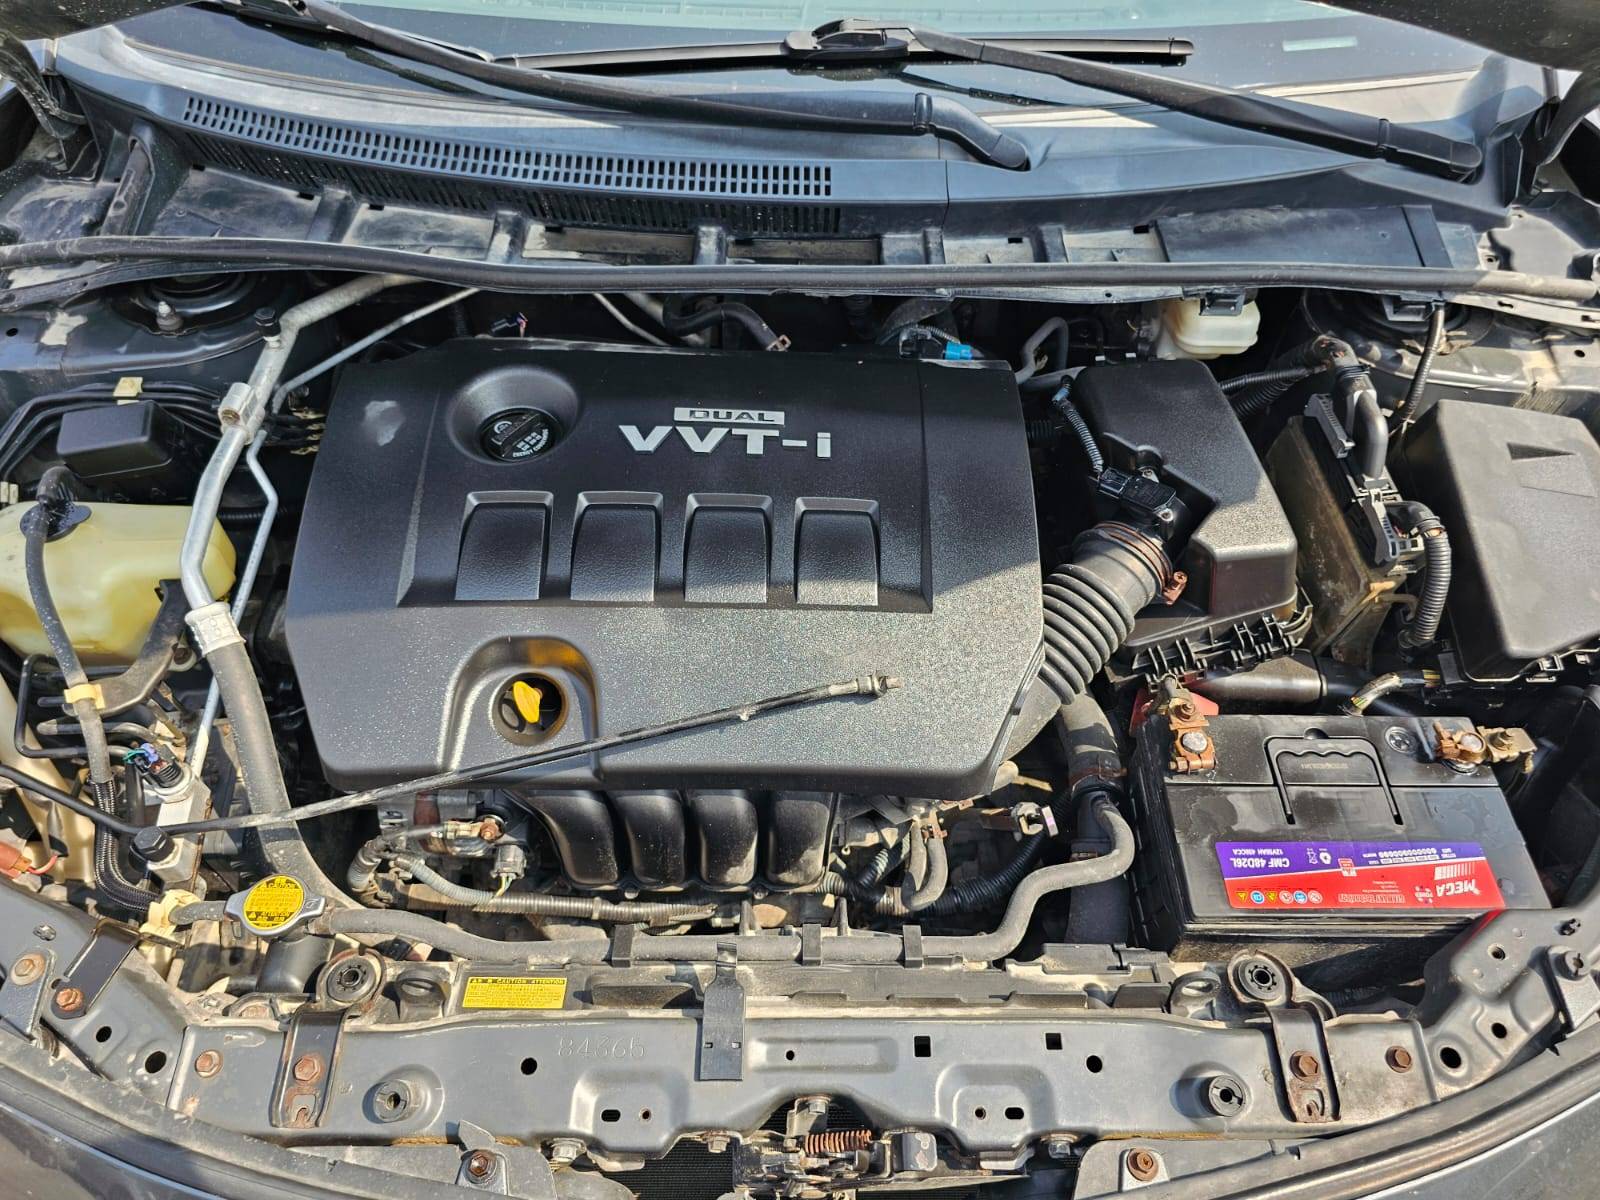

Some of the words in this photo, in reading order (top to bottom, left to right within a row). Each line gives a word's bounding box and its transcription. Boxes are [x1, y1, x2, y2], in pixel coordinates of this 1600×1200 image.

[689, 409, 775, 422] DUAL
[618, 424, 832, 459] VVT-i
[1230, 857, 1267, 868] 48D26L
[1267, 857, 1290, 868] CMF
[1435, 879, 1480, 897] MEGA
